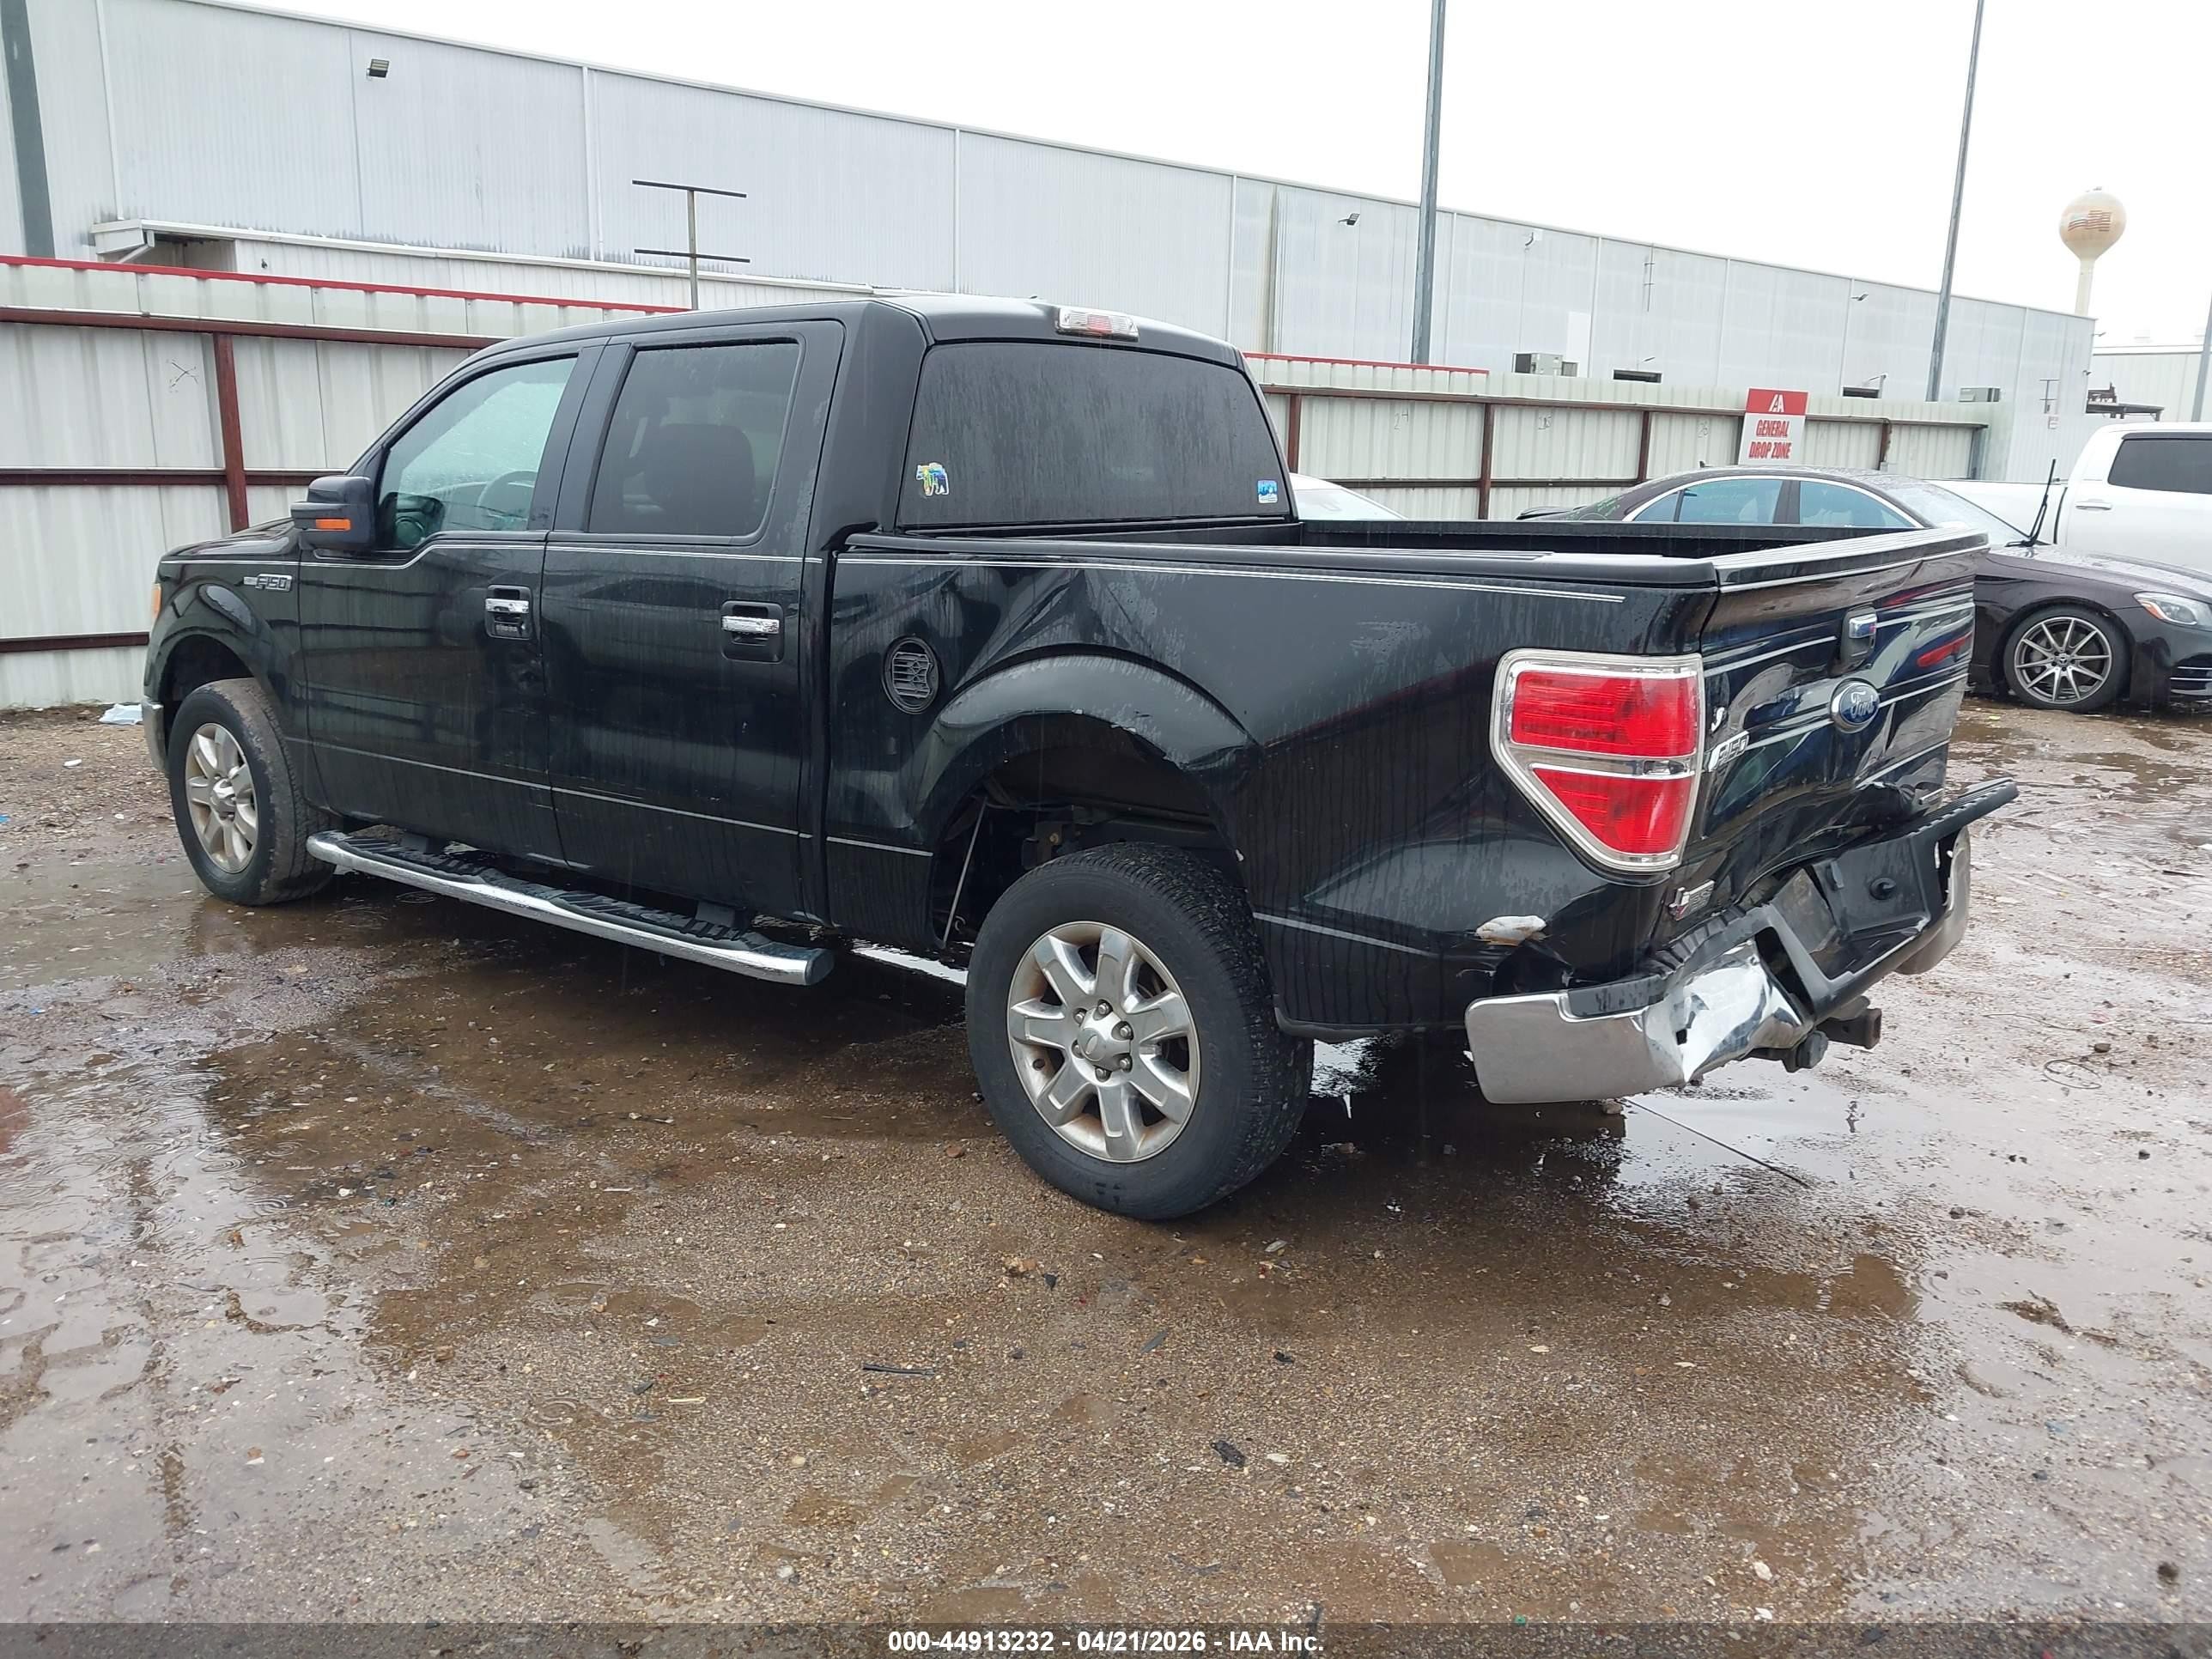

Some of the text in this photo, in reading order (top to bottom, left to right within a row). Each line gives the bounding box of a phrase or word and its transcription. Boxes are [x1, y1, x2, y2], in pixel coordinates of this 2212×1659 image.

[1755, 419, 1790, 437] GENERAL
[1748, 441, 1791, 459] DROP ZONE
[1850, 690, 1875, 719] Ford
